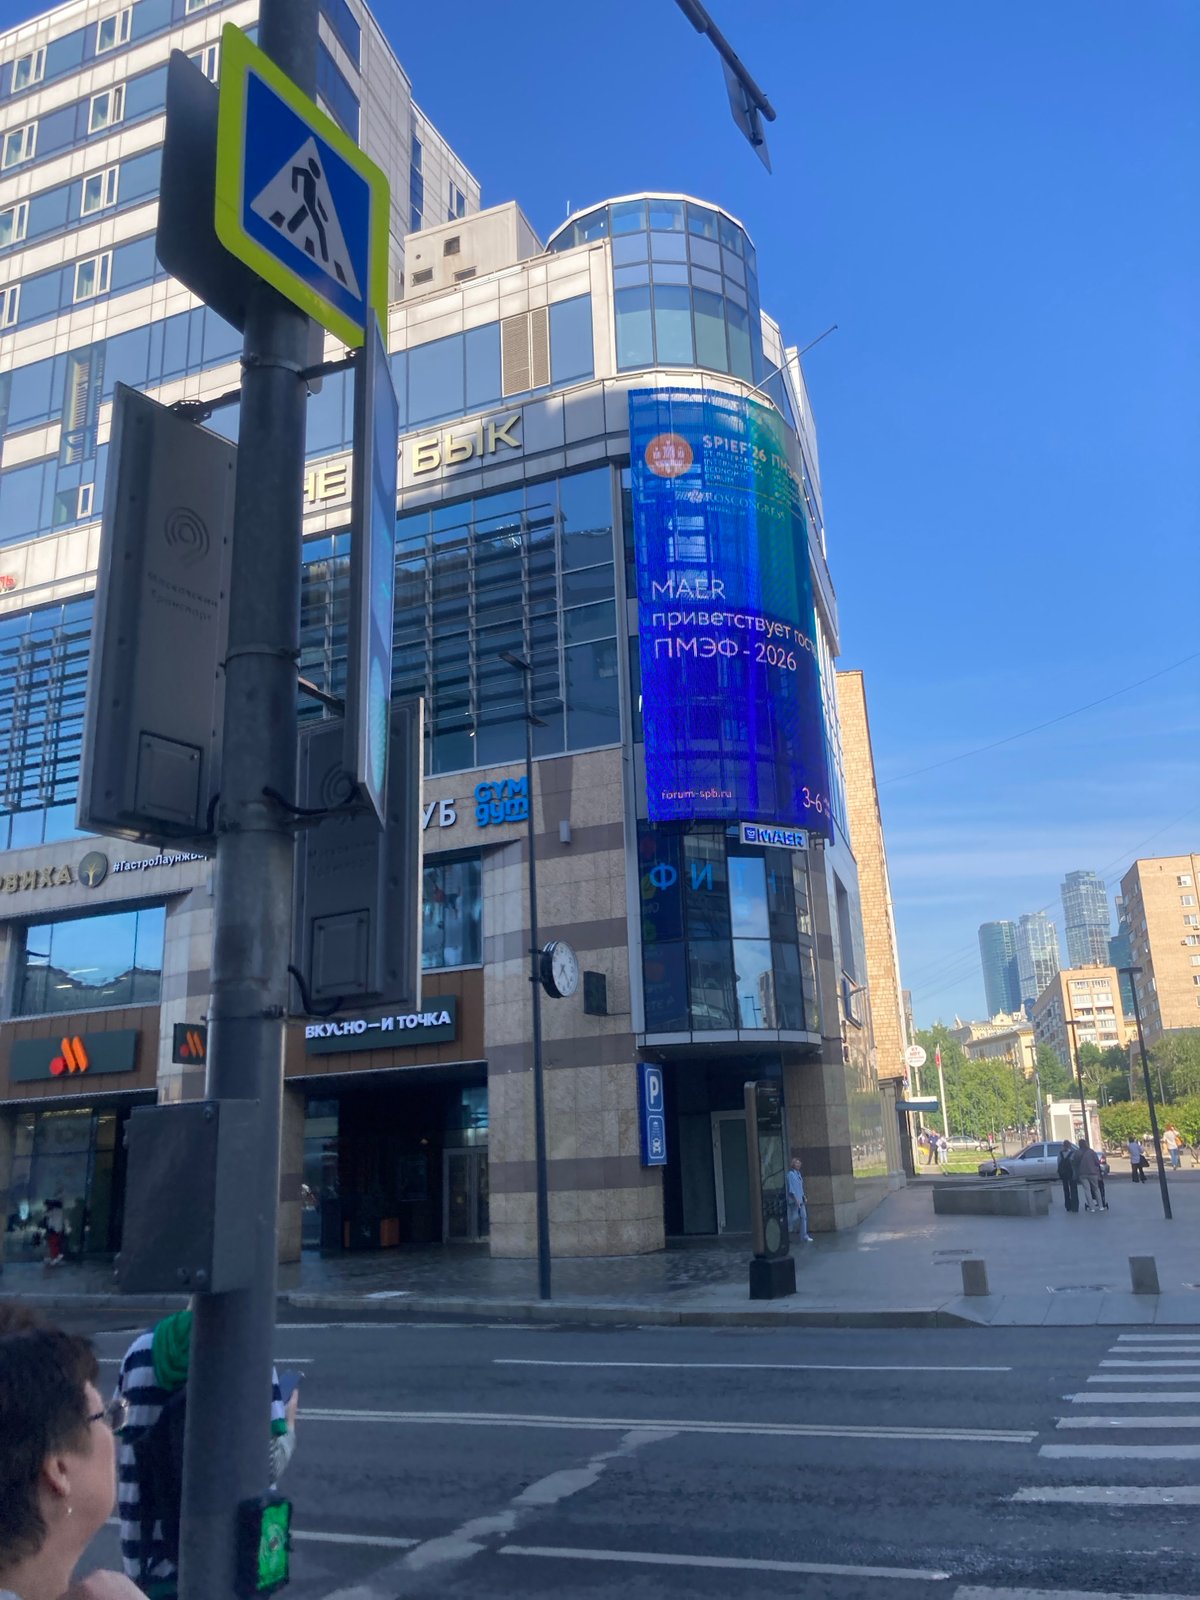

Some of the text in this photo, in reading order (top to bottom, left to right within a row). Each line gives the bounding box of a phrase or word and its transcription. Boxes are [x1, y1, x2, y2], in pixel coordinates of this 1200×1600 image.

[413, 416, 522, 475] БЫК
[651, 579, 727, 600] MAER
[652, 610, 791, 638] приветствует
[655, 637, 739, 660] ПМЭФ
[754, 642, 797, 672] 2026
[474, 776, 528, 802] GYM
[661, 788, 733, 801] forum-spb.ru
[475, 797, 529, 827] gym
[757, 828, 804, 848] MAER
[0, 864, 72, 894] ВИХА
[397, 1010, 452, 1030] ТОЧКА
